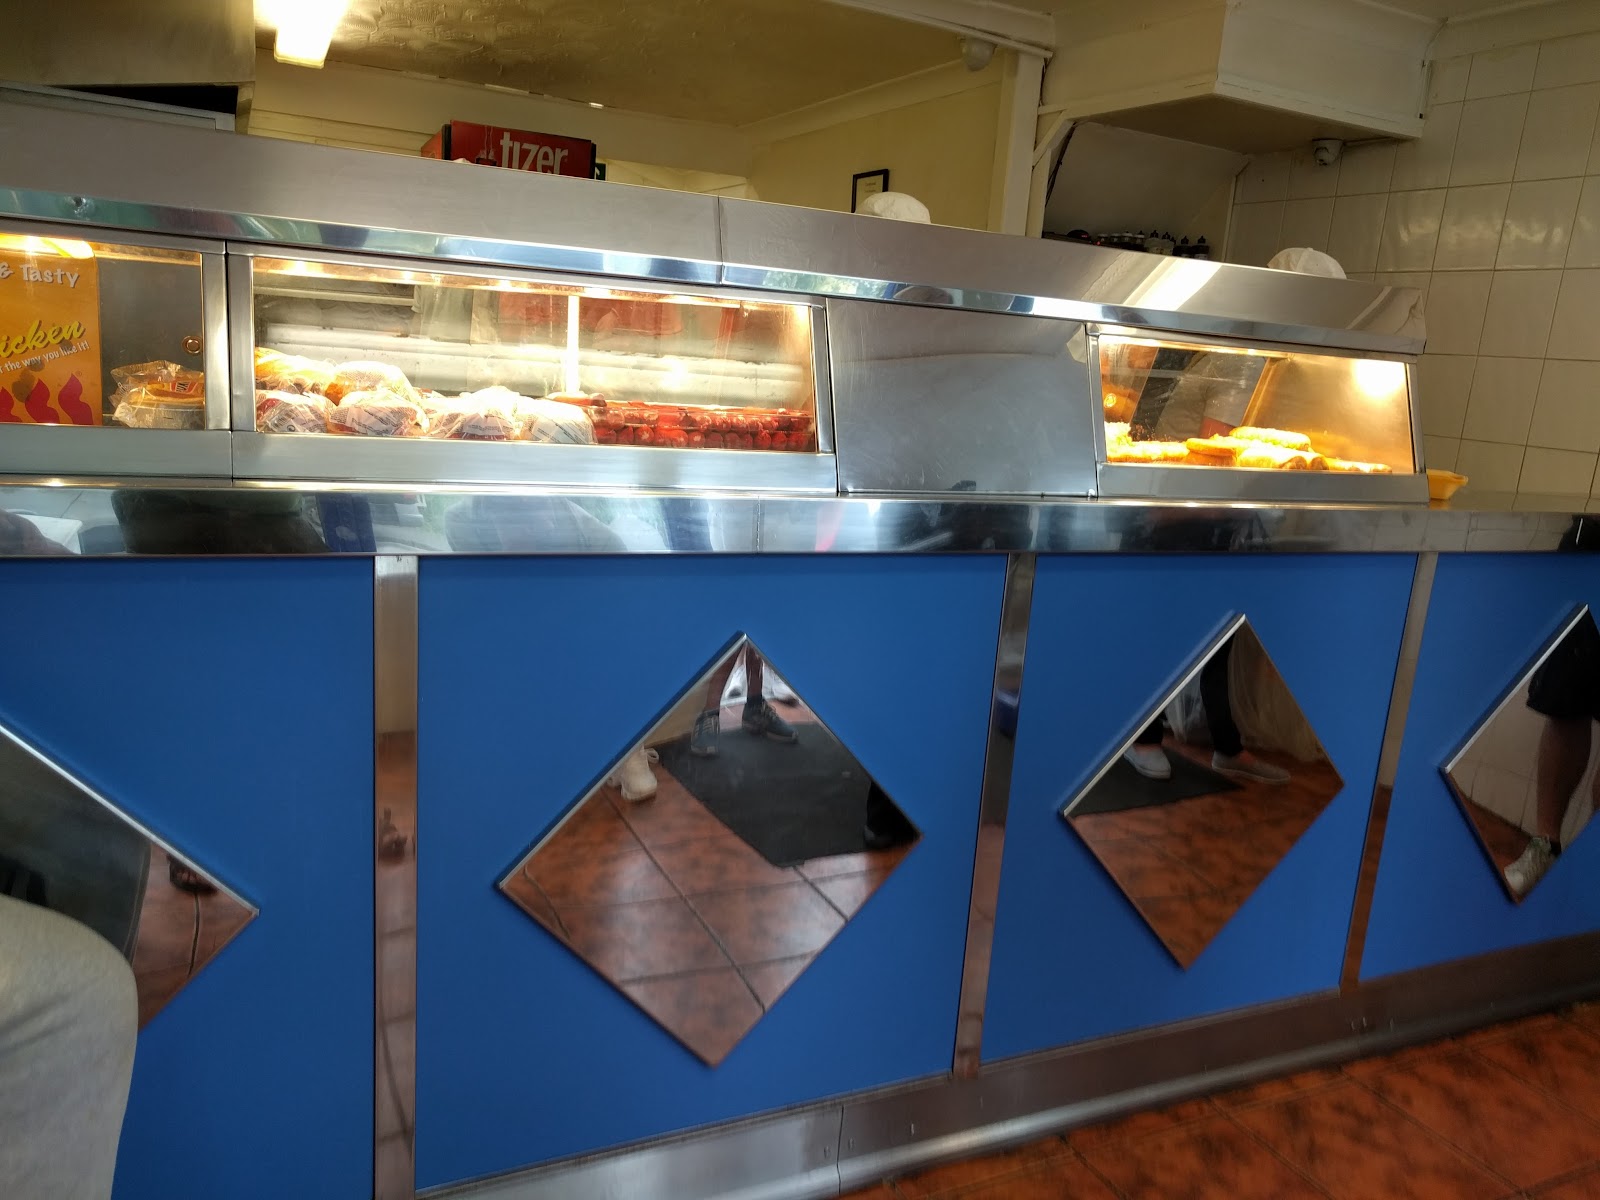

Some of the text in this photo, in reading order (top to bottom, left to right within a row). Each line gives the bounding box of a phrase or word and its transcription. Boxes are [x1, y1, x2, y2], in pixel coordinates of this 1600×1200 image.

[500, 131, 568, 175] tizer
[21, 264, 79, 288] Tasty
[5, 361, 21, 373] the
[22, 356, 41, 368] way
[43, 350, 59, 363] you
[60, 345, 77, 357] like
